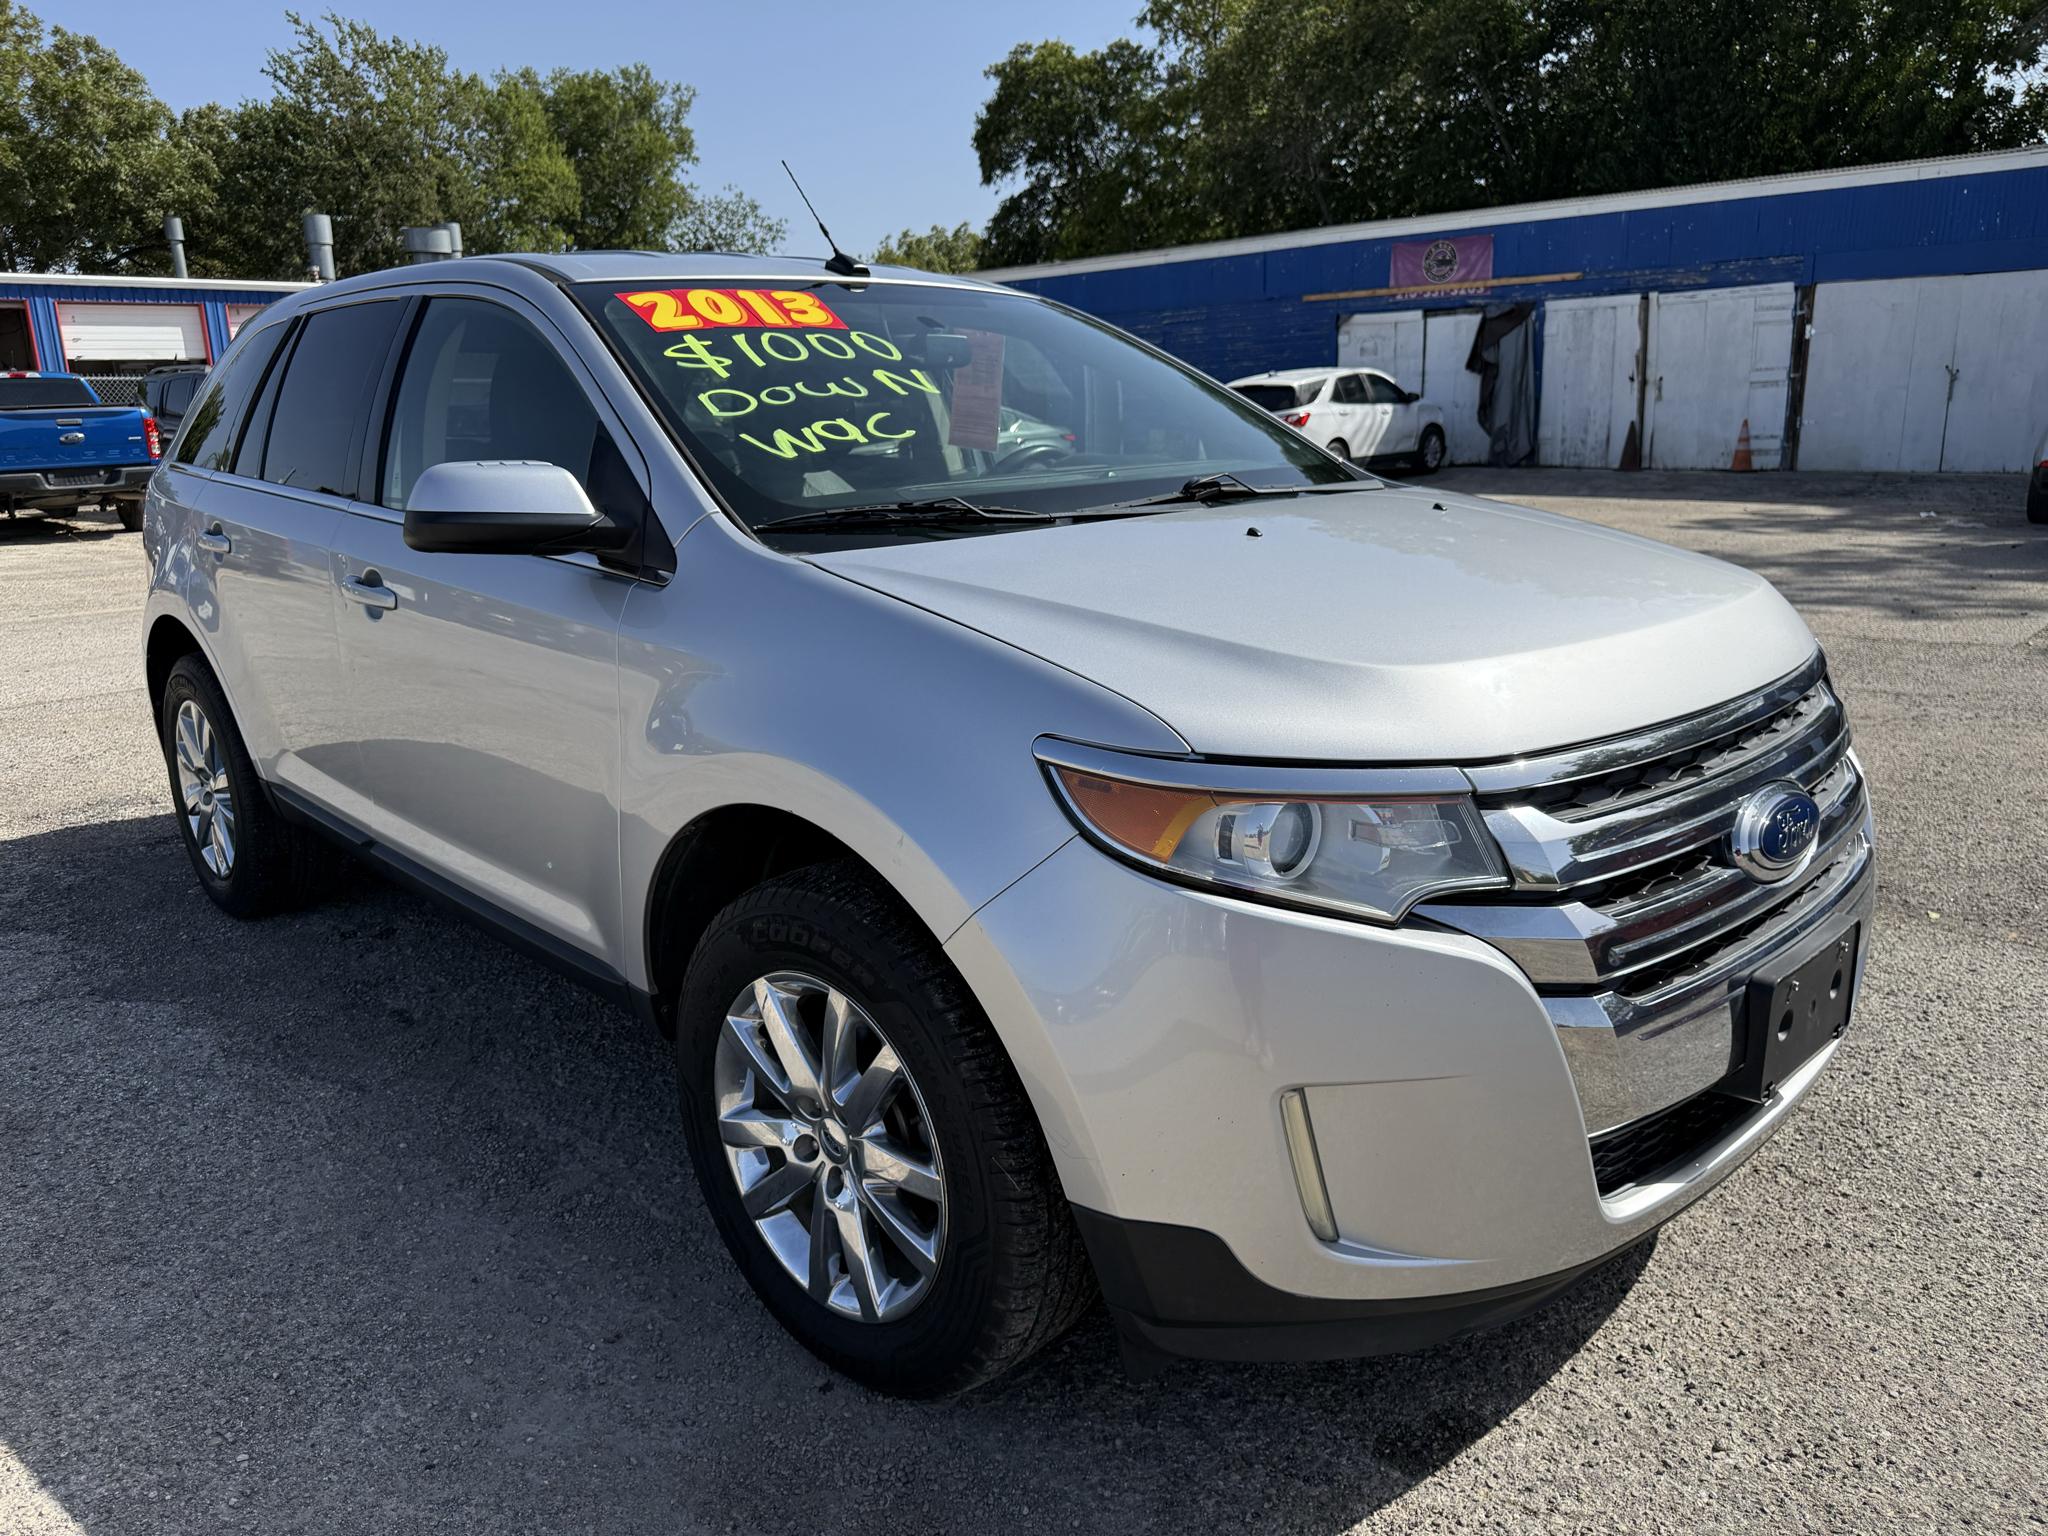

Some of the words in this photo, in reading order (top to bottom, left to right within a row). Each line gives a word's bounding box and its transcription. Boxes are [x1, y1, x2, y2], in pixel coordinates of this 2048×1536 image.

[627, 289, 833, 328] 2013
[663, 331, 903, 379] $1000
[1776, 804, 1814, 854] Ford
